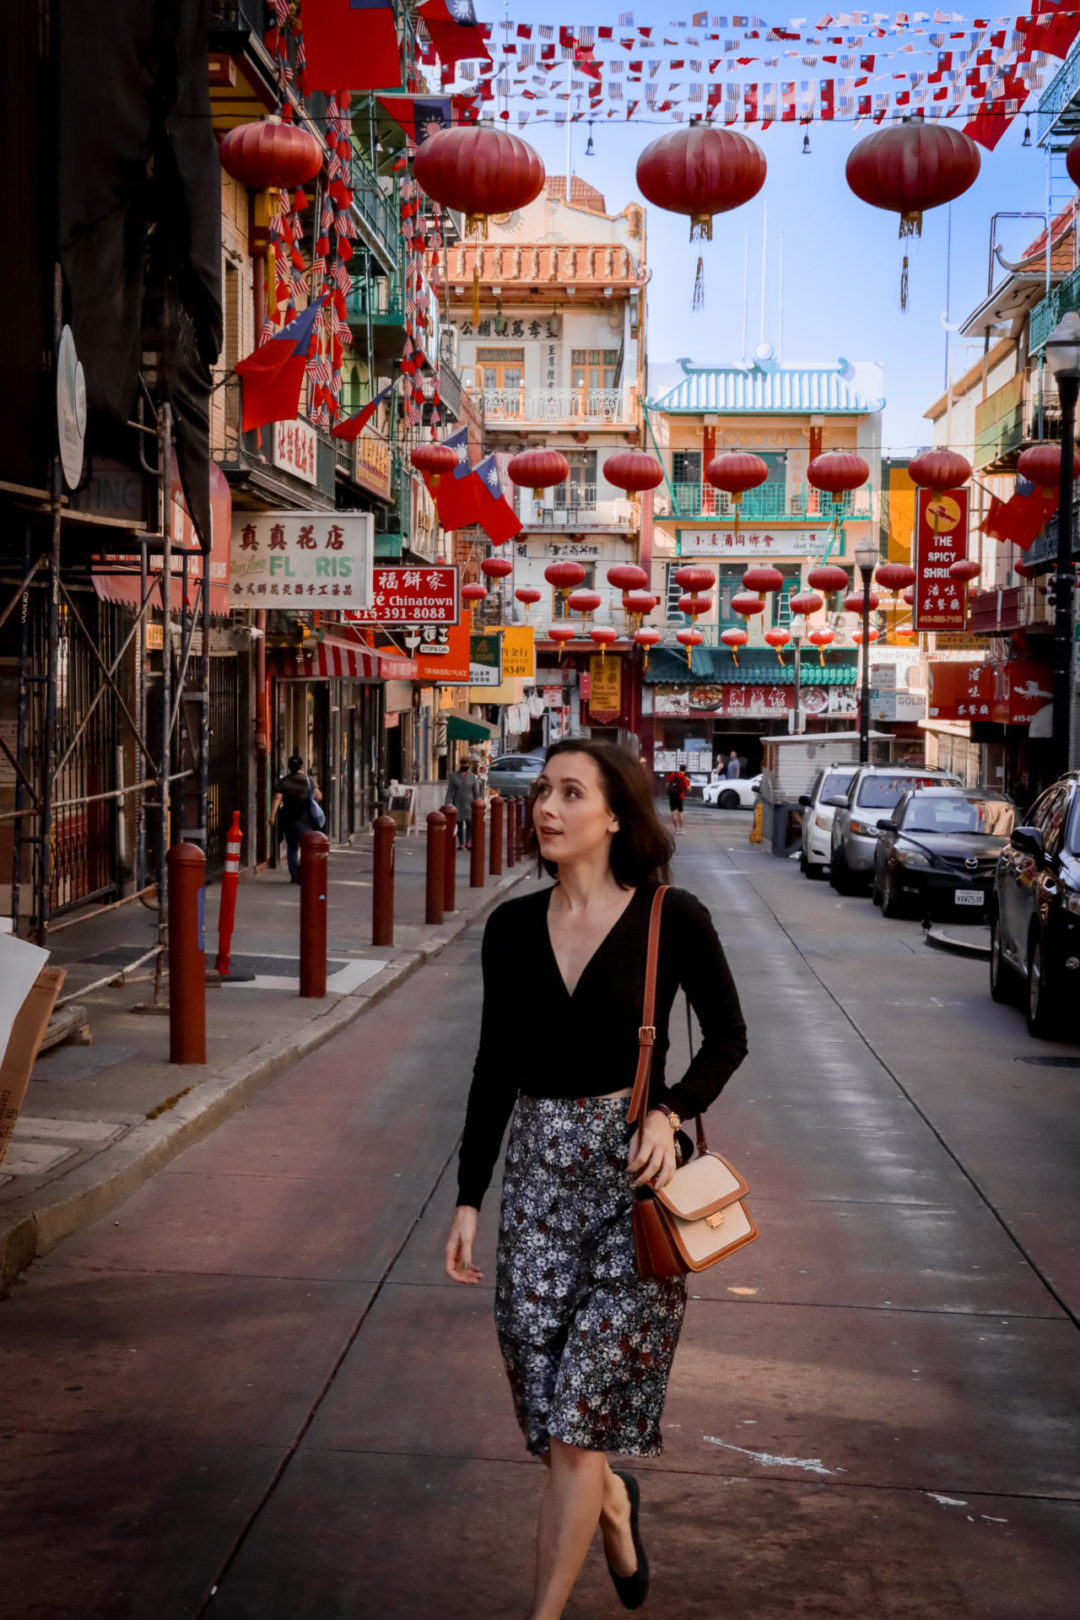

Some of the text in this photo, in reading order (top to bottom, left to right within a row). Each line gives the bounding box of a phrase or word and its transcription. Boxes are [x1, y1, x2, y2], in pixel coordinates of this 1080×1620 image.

[239, 523, 345, 551] 真真花店
[933, 536, 953, 547] THE
[928, 552, 957, 563] SPICY
[923, 567, 951, 578] SHRI
[378, 571, 447, 590] 福餅家
[389, 595, 453, 606] Chinatown
[354, 607, 446, 619] 415-391-8088
